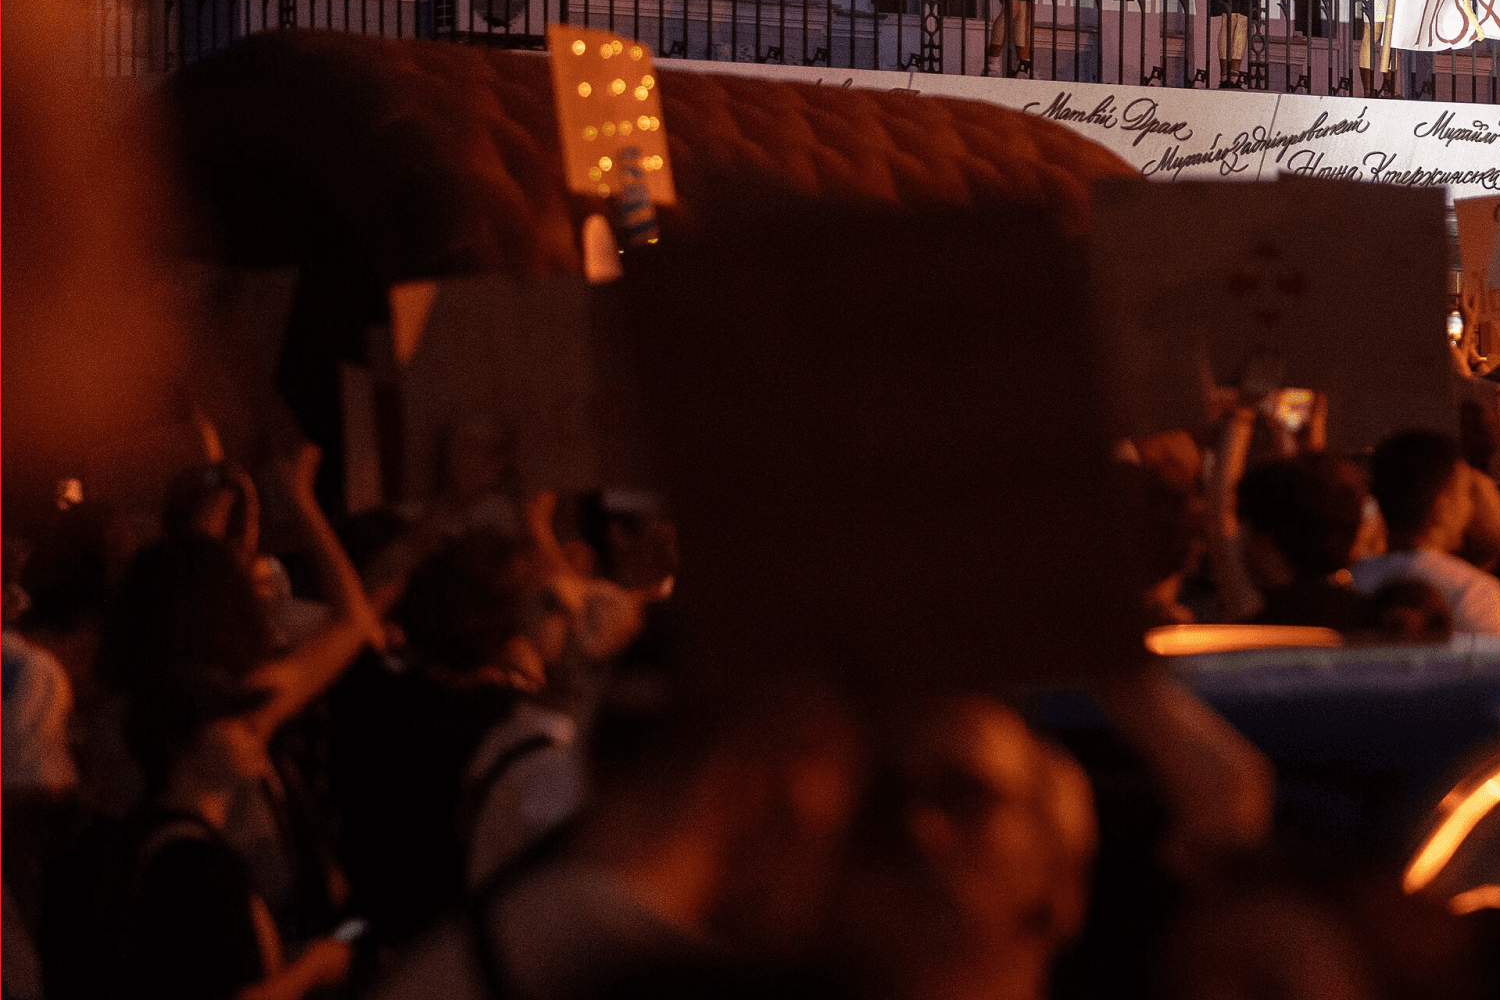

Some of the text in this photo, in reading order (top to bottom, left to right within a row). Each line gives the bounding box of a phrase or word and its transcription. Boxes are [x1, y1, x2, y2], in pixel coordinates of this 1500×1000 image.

[1023, 91, 1193, 147] Матвій Драк
[1141, 133, 1236, 181] Михайло
